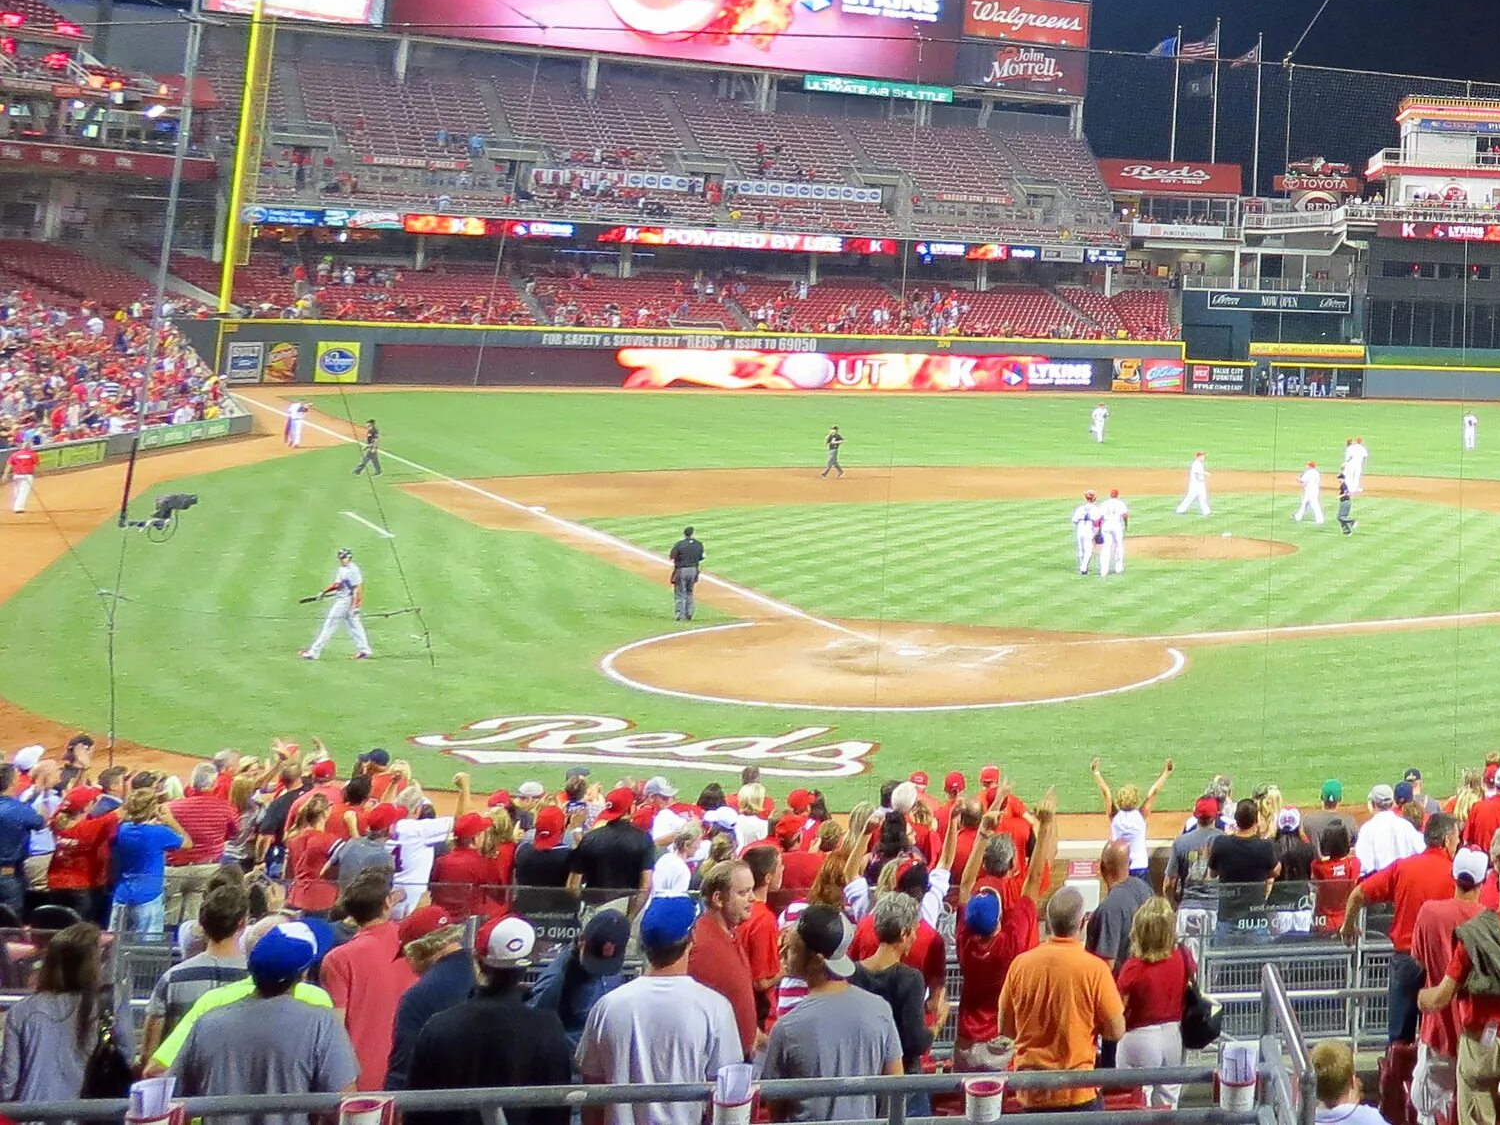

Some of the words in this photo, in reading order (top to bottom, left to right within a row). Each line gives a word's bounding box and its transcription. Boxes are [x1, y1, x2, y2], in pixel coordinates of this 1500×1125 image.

[971, 0, 1083, 32] Walgreens
[1014, 48, 1044, 62] John
[983, 57, 1064, 83] Morrell
[806, 80, 867, 94] ULTIMATE
[869, 88, 889, 97] AIR
[1120, 164, 1211, 180] Reds
[1301, 178, 1348, 189] TOYOTA
[1307, 204, 1338, 212] REDS
[1402, 223, 1415, 236] K
[1448, 226, 1484, 236] LYKINS
[625, 227, 639, 242] K
[662, 229, 768, 249] POWERED
[771, 233, 798, 251] BY
[800, 235, 843, 253] LIFE
[869, 239, 882, 252] K
[1261, 296, 1278, 307] NOW
[1280, 297, 1298, 308] OPEN
[542, 334, 562, 345] FOR
[564, 334, 602, 346] SAFETY
[603, 336, 611, 346] &
[613, 335, 655, 347] SERVICE
[657, 337, 680, 348] TEXT
[735, 338, 762, 350] ISSUE
[765, 339, 777, 350] TO
[778, 337, 817, 352] 69050
[951, 357, 978, 388] K
[1028, 362, 1091, 379] LYKINS
[1213, 367, 1229, 375] VALUE
[1231, 368, 1244, 376] CITY
[1213, 374, 1243, 382] FURNITURE
[406, 713, 881, 777] Reds
